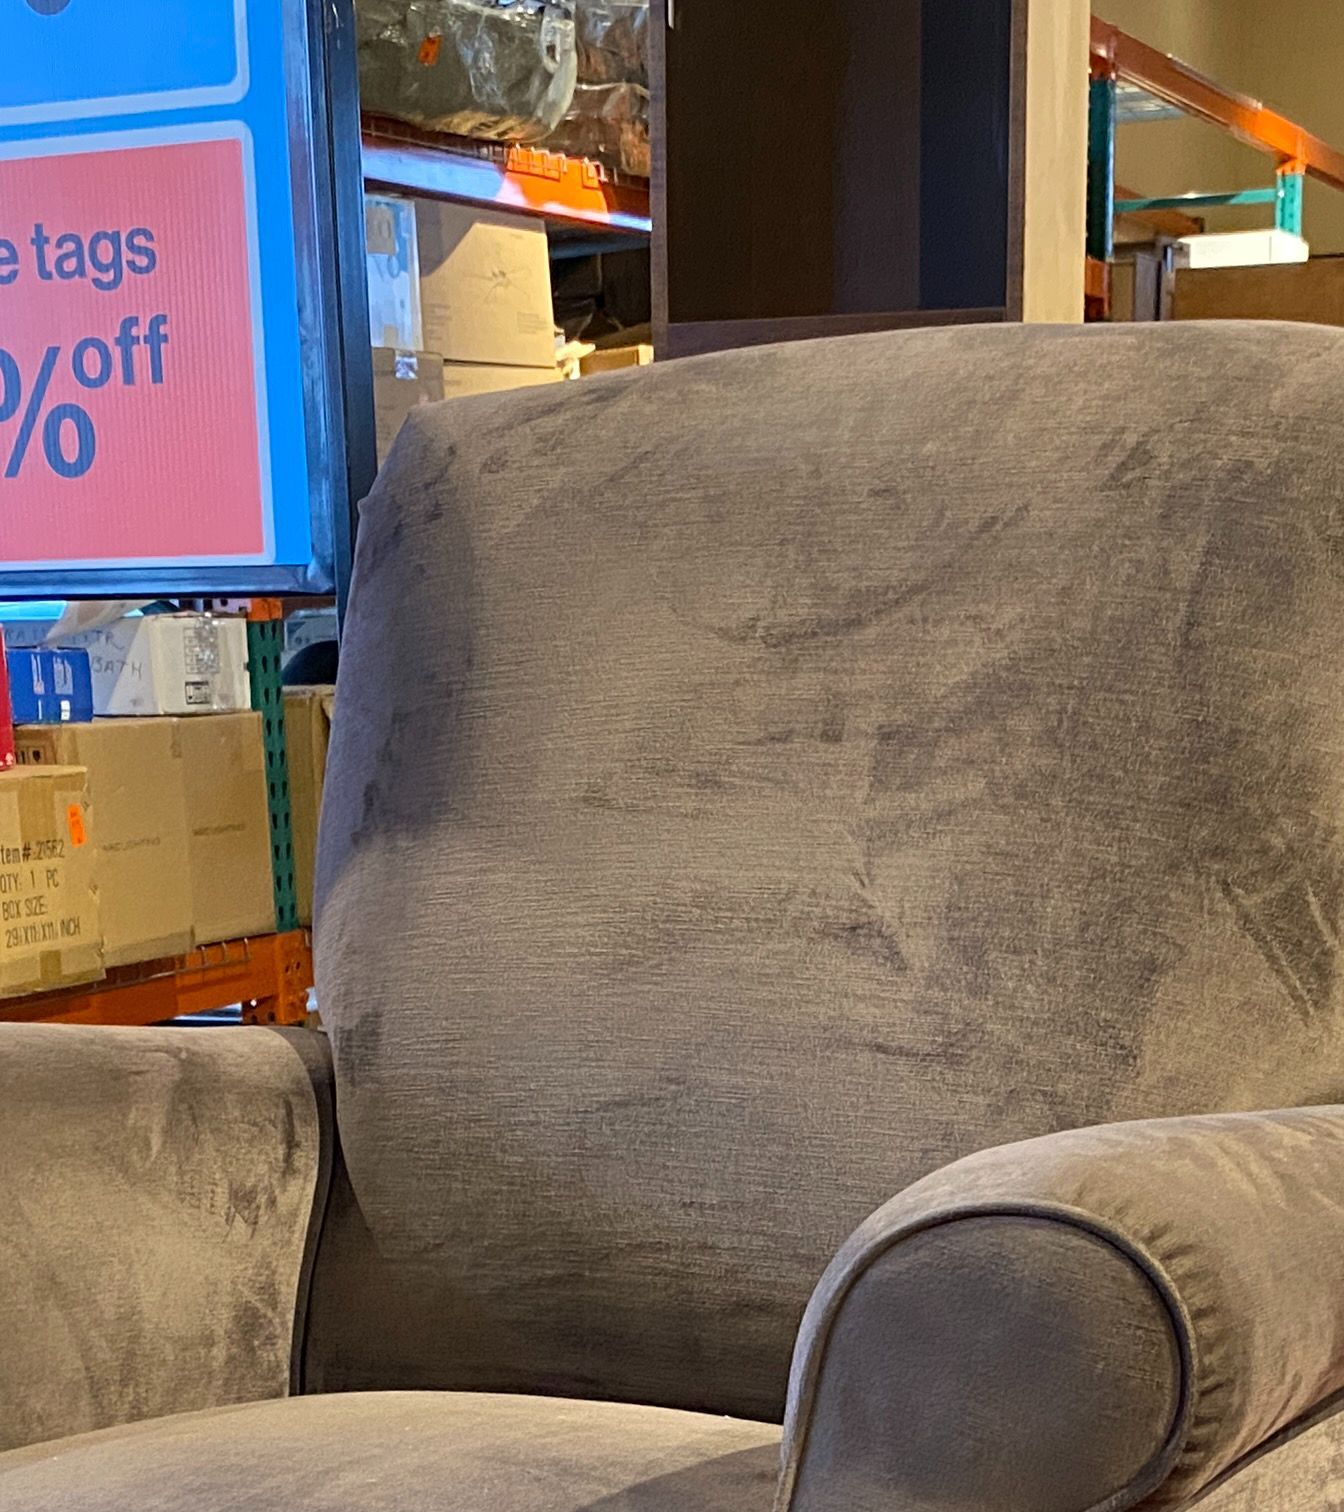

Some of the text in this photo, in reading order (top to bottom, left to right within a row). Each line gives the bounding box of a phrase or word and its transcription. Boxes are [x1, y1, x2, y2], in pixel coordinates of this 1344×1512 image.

[30, 223, 158, 291] tags
[72, 314, 168, 389] off
[46, 869, 60, 888] PC
[2, 899, 22, 920] BOX
